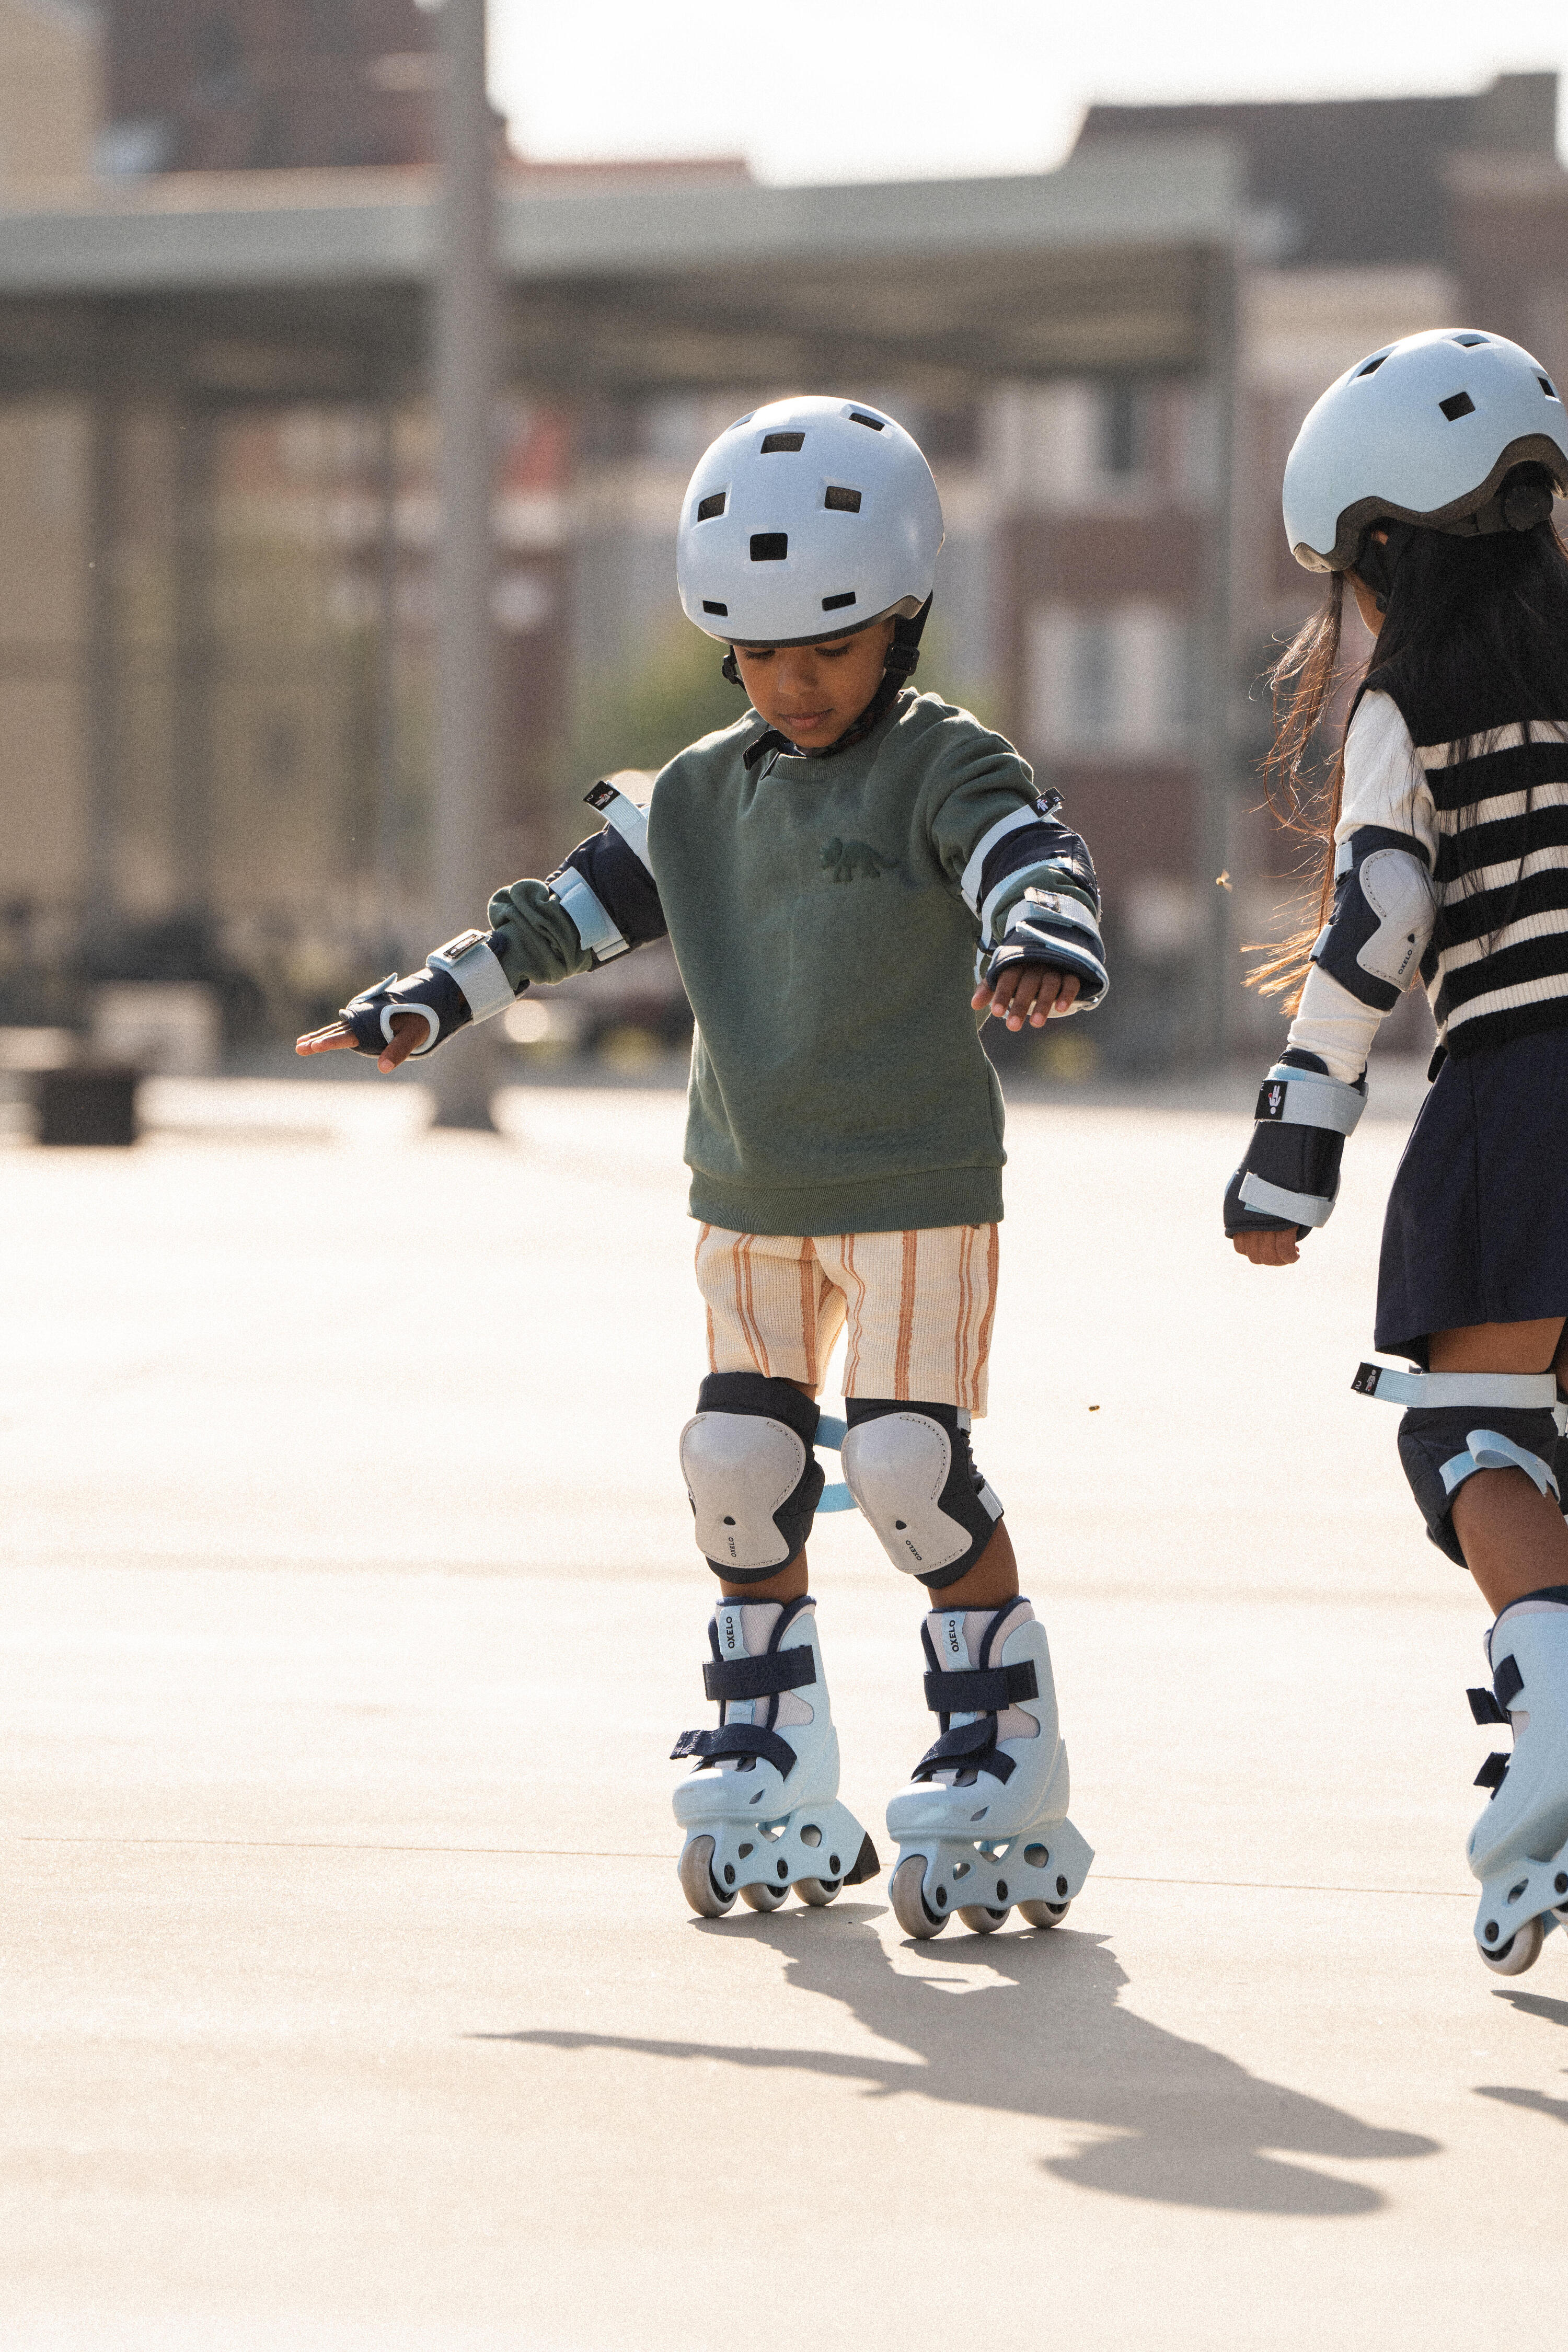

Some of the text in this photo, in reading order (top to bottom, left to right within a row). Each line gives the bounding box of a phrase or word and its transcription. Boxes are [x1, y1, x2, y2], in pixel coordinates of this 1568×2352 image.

[1398, 950, 1412, 975] OXELO
[728, 1537, 736, 1558] OXELO
[905, 1540, 922, 1561] OXELO
[726, 1616, 735, 1649] OXELO
[949, 1620, 960, 1652] OXELO
